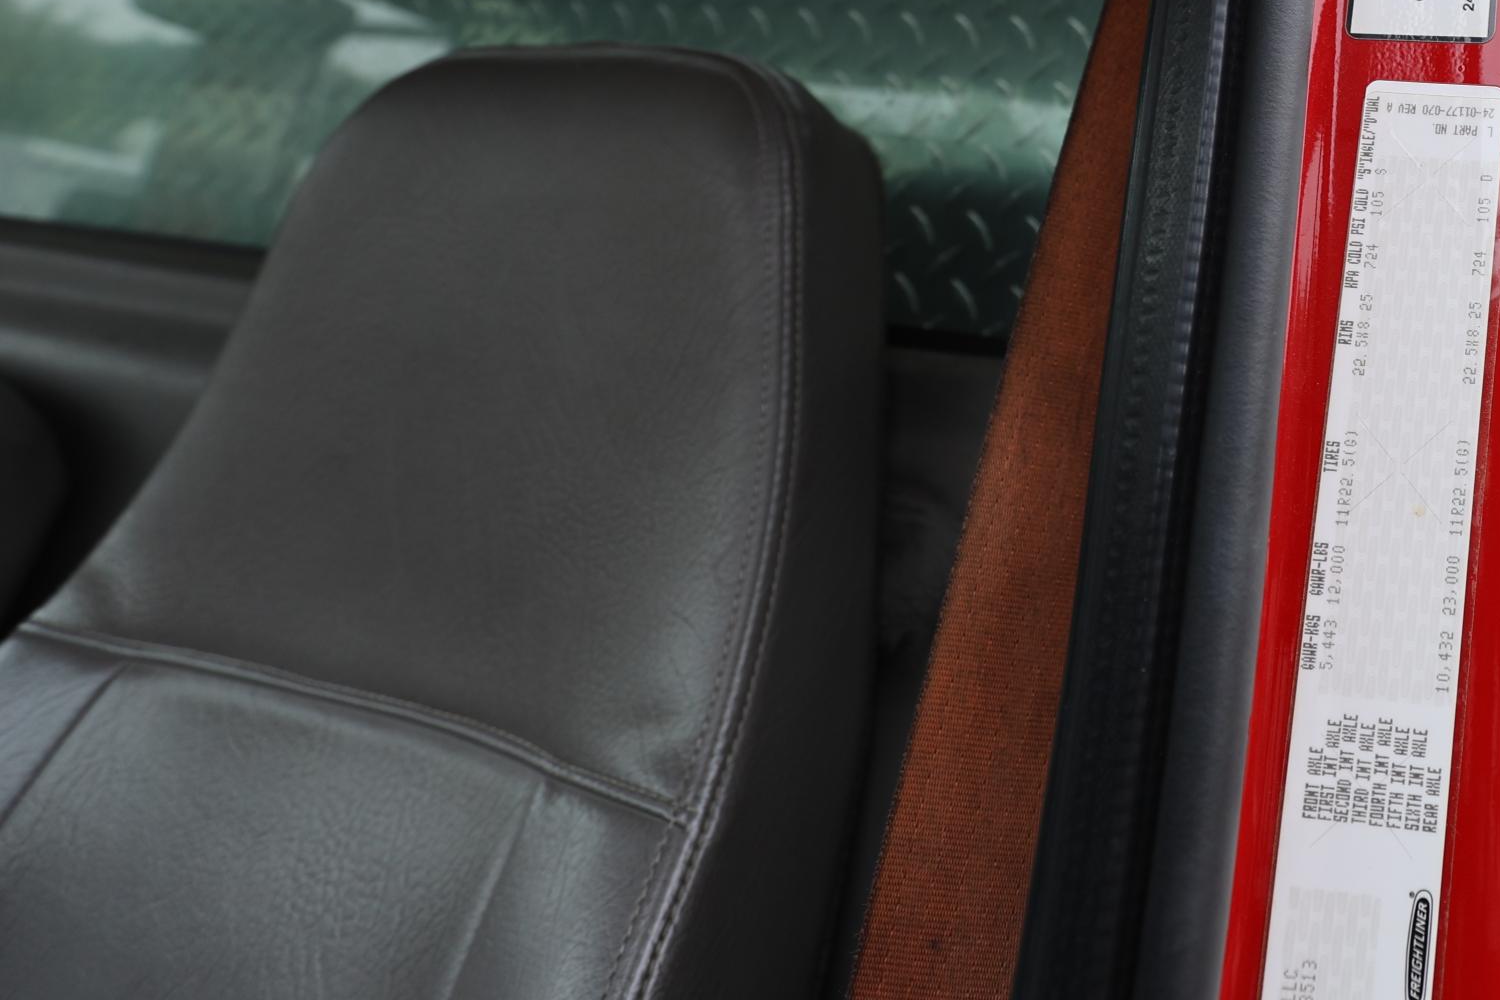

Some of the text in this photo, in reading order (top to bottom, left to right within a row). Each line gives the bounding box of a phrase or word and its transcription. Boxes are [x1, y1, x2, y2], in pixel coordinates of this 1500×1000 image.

[1395, 103, 1419, 114] REV
[1452, 125, 1477, 136] PART
[1354, 189, 1368, 211] COLD
[1370, 192, 1384, 216] 105
[1477, 198, 1491, 222] 105
[1351, 218, 1365, 235] PSI
[1348, 241, 1362, 264] COLD
[1364, 244, 1378, 269] 724
[1472, 252, 1486, 275] 724
[1344, 271, 1360, 288] KPA
[1338, 320, 1354, 344] RIMS
[1323, 441, 1340, 472] TIRES
[1327, 545, 1345, 605] 12,000
[1442, 556, 1460, 615] 23,000
[1319, 620, 1337, 670] 5,443
[1435, 631, 1453, 694] 10,432
[1302, 747, 1323, 819] FRONT AXLE
[1319, 720, 1341, 821] FIRST INT AXLE
[1334, 714, 1358, 823] SECOND INT AXLE
[1351, 723, 1375, 824] THIRD INT AXLE
[1370, 717, 1393, 826] FOURTH INT AXLE
[1387, 726, 1410, 829] FIFTH INT AXLE
[1404, 729, 1428, 831] SIXTH INT AXLE
[1423, 767, 1441, 833] REAR AXLE
[1410, 902, 1428, 1000] FREIGHTLINER
